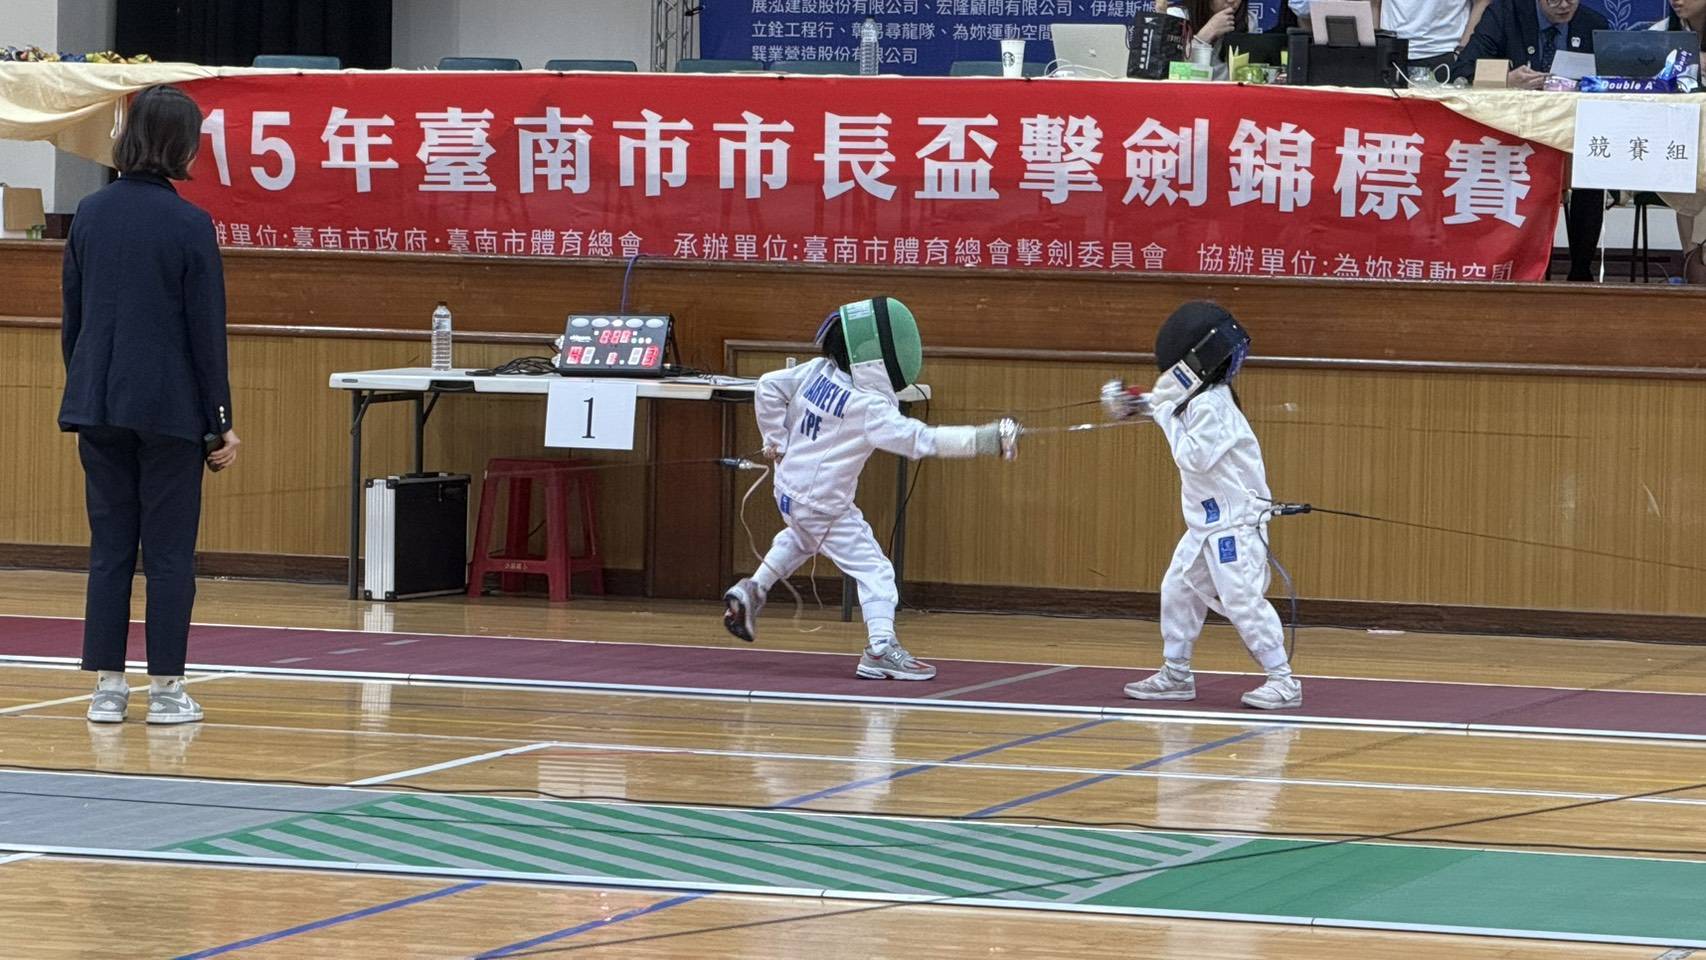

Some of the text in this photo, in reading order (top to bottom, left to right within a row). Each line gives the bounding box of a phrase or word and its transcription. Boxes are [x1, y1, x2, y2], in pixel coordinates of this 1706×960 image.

[1601, 80, 1654, 90] Double A
[582, 397, 595, 439] 1
